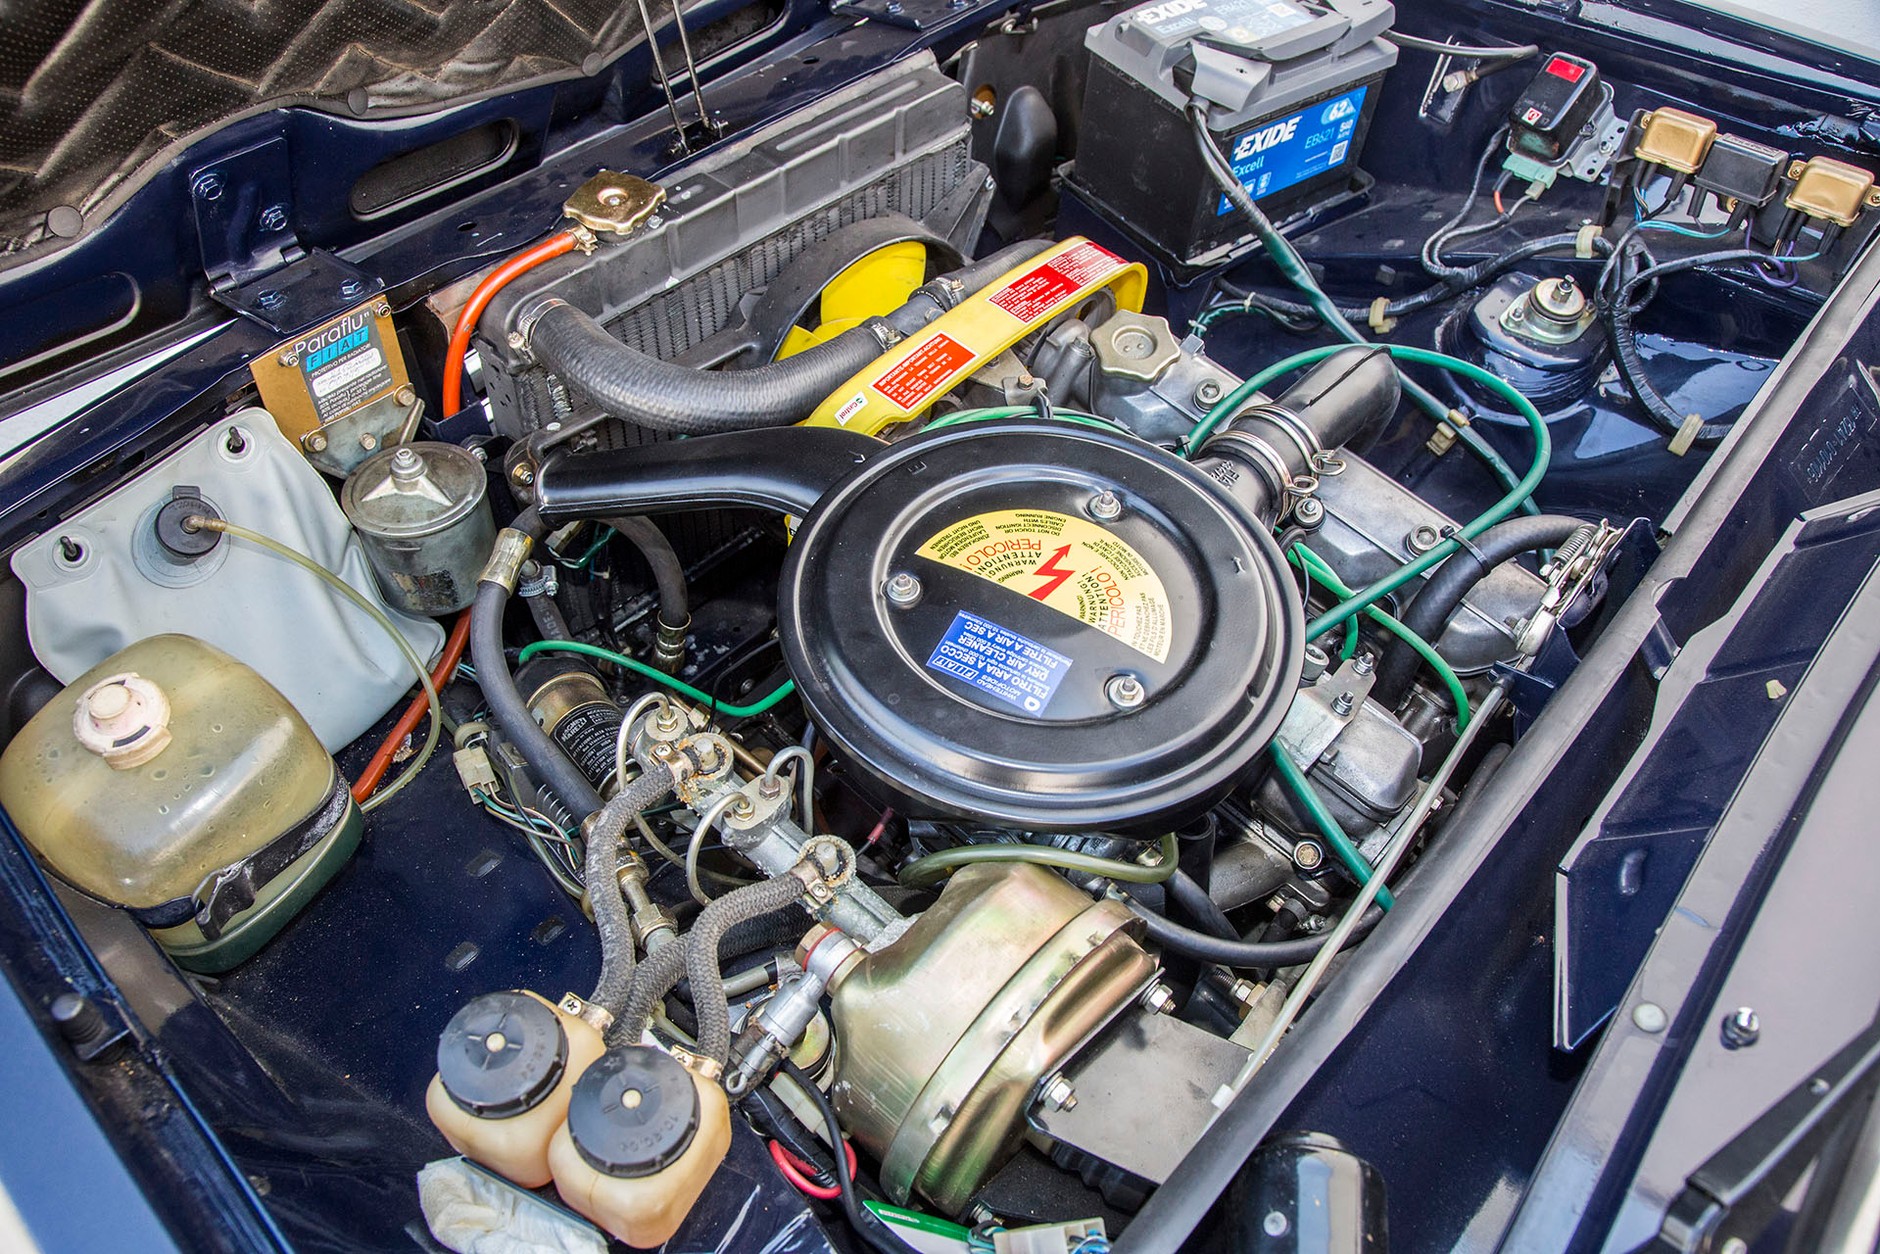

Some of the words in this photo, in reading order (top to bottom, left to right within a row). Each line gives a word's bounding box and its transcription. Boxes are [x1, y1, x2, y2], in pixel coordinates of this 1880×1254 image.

[1234, 114, 1302, 161] EXIDE
[1304, 127, 1335, 149] EB621
[1232, 156, 1264, 178] Excell
[295, 311, 365, 356] Paraflu
[306, 327, 369, 370] FIAT
[1023, 523, 1061, 531] DISCONNECT
[959, 538, 1040, 570] PERICOLO!
[973, 551, 1041, 575] ATTENTION!
[985, 559, 1036, 577] WARNUNG!
[1077, 579, 1096, 622] WARNUNG!
[1082, 572, 1108, 630] ATTENTION!
[1090, 565, 1125, 636] PERICOLO!
[962, 620, 987, 636] SEC
[984, 629, 996, 639] A
[956, 633, 1007, 662] CLEANER
[993, 633, 1014, 648] AIR
[1011, 641, 1023, 652] A
[938, 643, 977, 666] SECCO
[974, 658, 986, 670] A
[1005, 655, 1027, 671] AIR
[1020, 645, 1059, 669] FILTRE
[931, 653, 979, 681] FIAT
[982, 662, 1012, 682] ARIA
[1023, 664, 1048, 681] DRY
[975, 677, 1017, 700] WHITEHEAD
[1009, 674, 1049, 699] FILTRO
